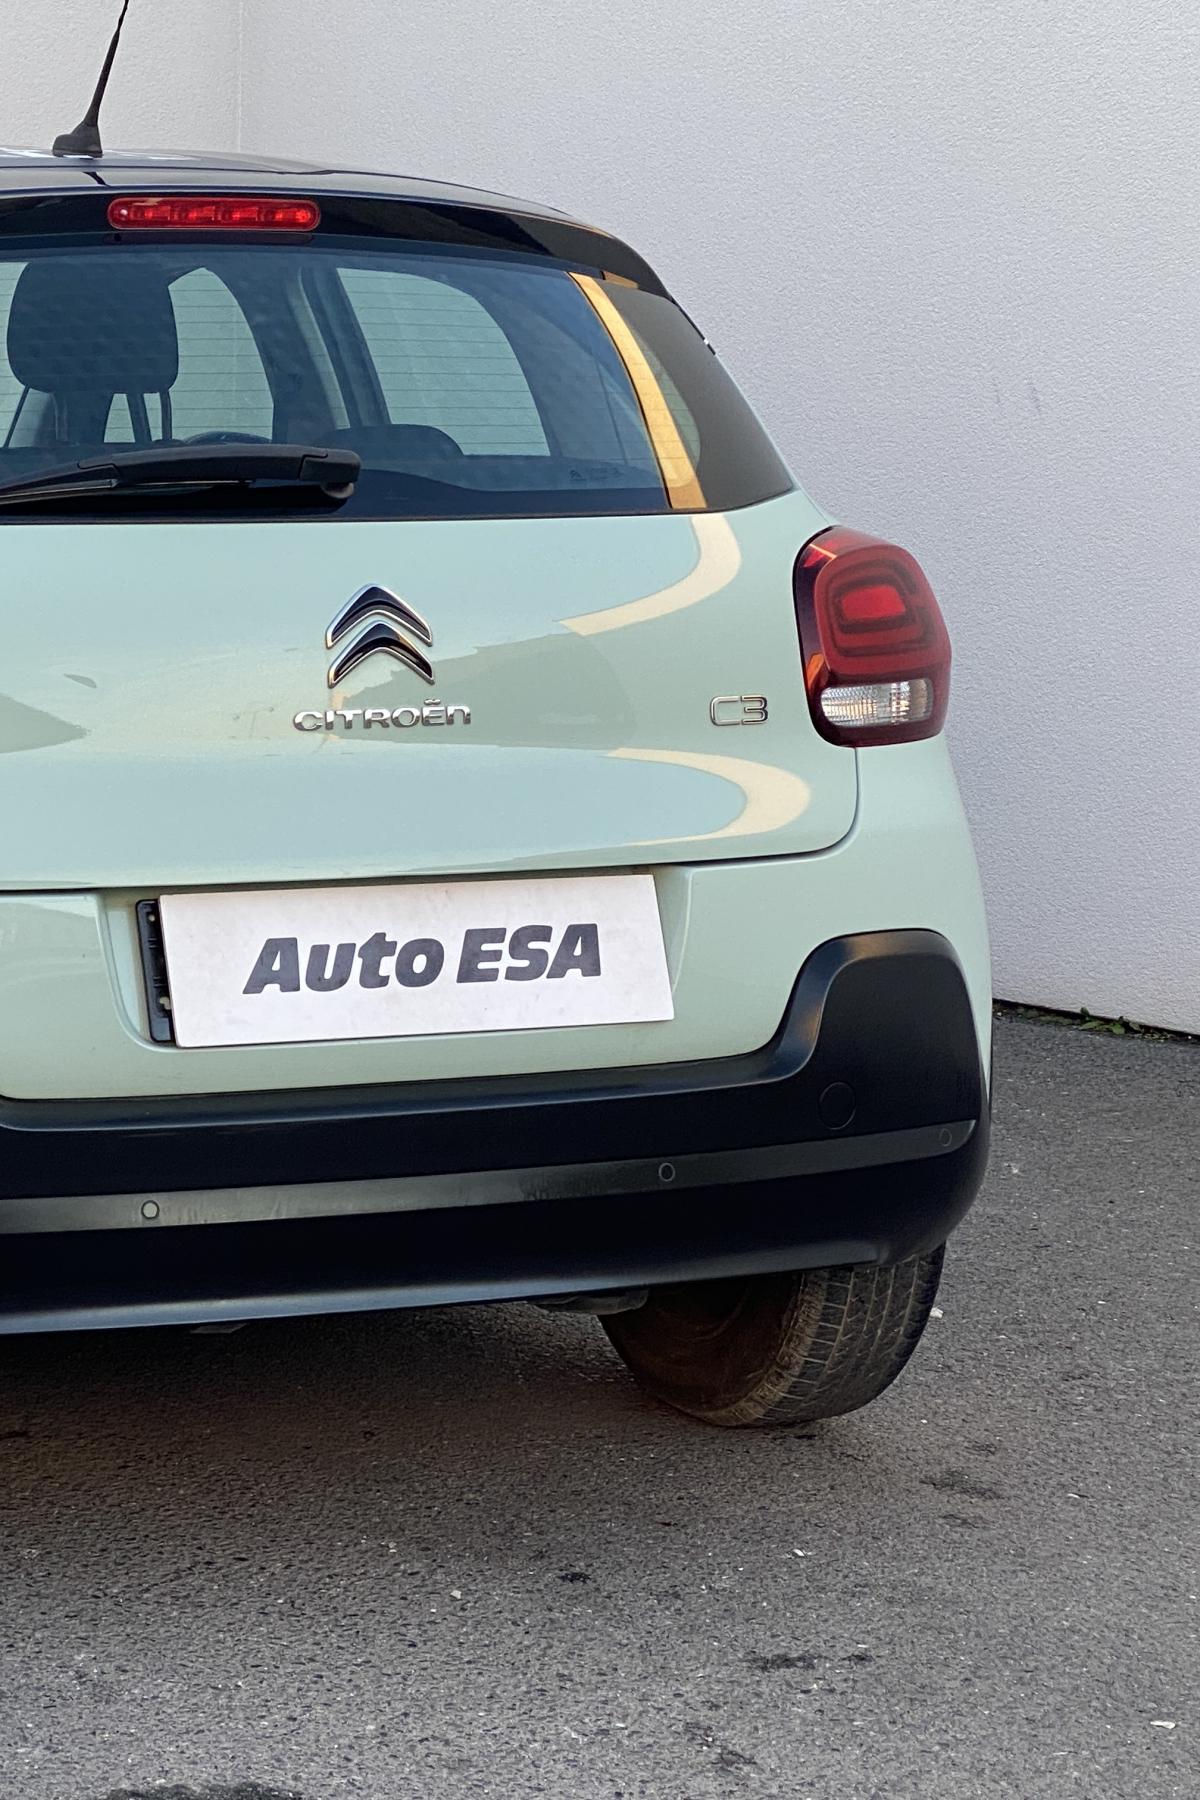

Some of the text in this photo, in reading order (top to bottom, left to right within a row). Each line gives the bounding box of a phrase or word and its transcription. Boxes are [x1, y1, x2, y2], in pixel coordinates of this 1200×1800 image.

[709, 695, 769, 726] C3
[242, 922, 601, 995] Auto ESA
